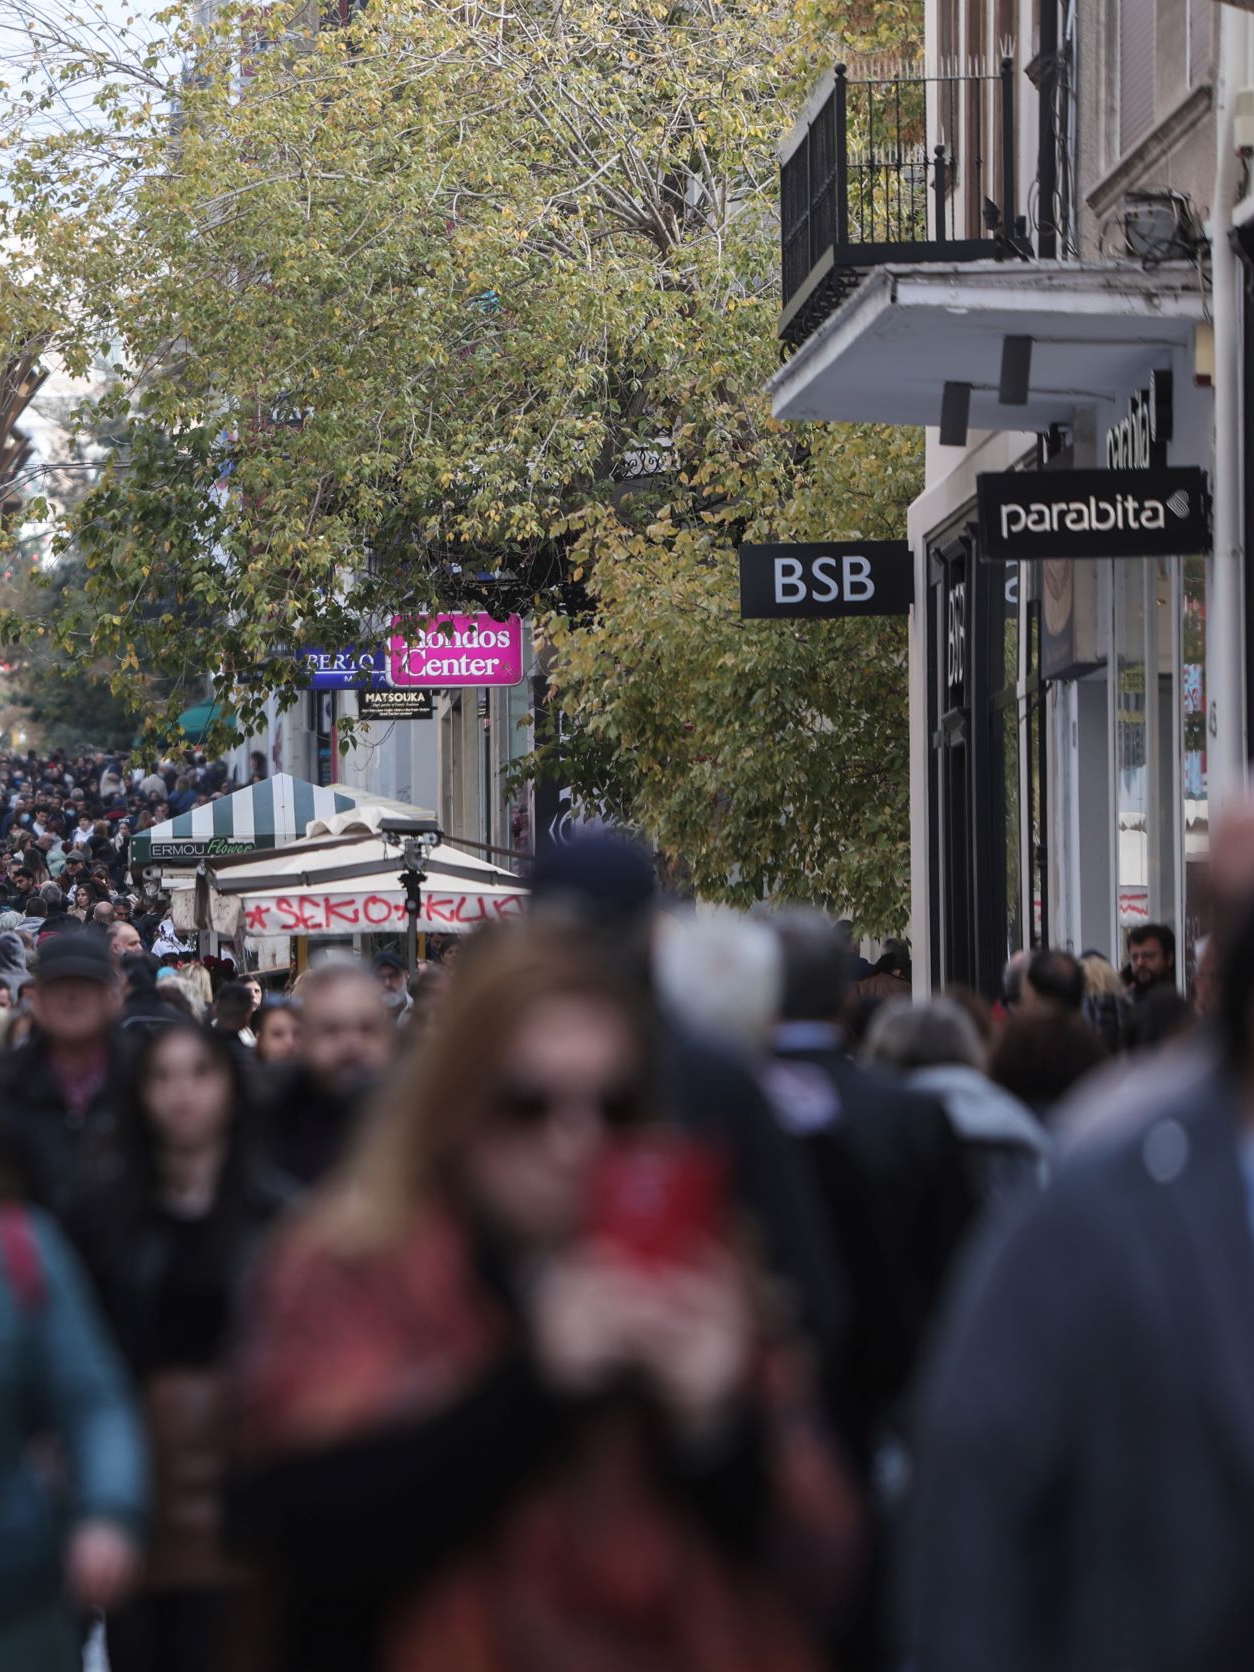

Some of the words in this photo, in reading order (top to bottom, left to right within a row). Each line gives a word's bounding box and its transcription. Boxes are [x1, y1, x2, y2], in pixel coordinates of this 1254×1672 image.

[1000, 493, 1164, 539] parabita
[774, 555, 875, 604] BSB
[402, 648, 500, 677] Center
[365, 692, 425, 704] MATSOUKA
[152, 844, 205, 856] ERMOU
[206, 838, 254, 855] Flower
